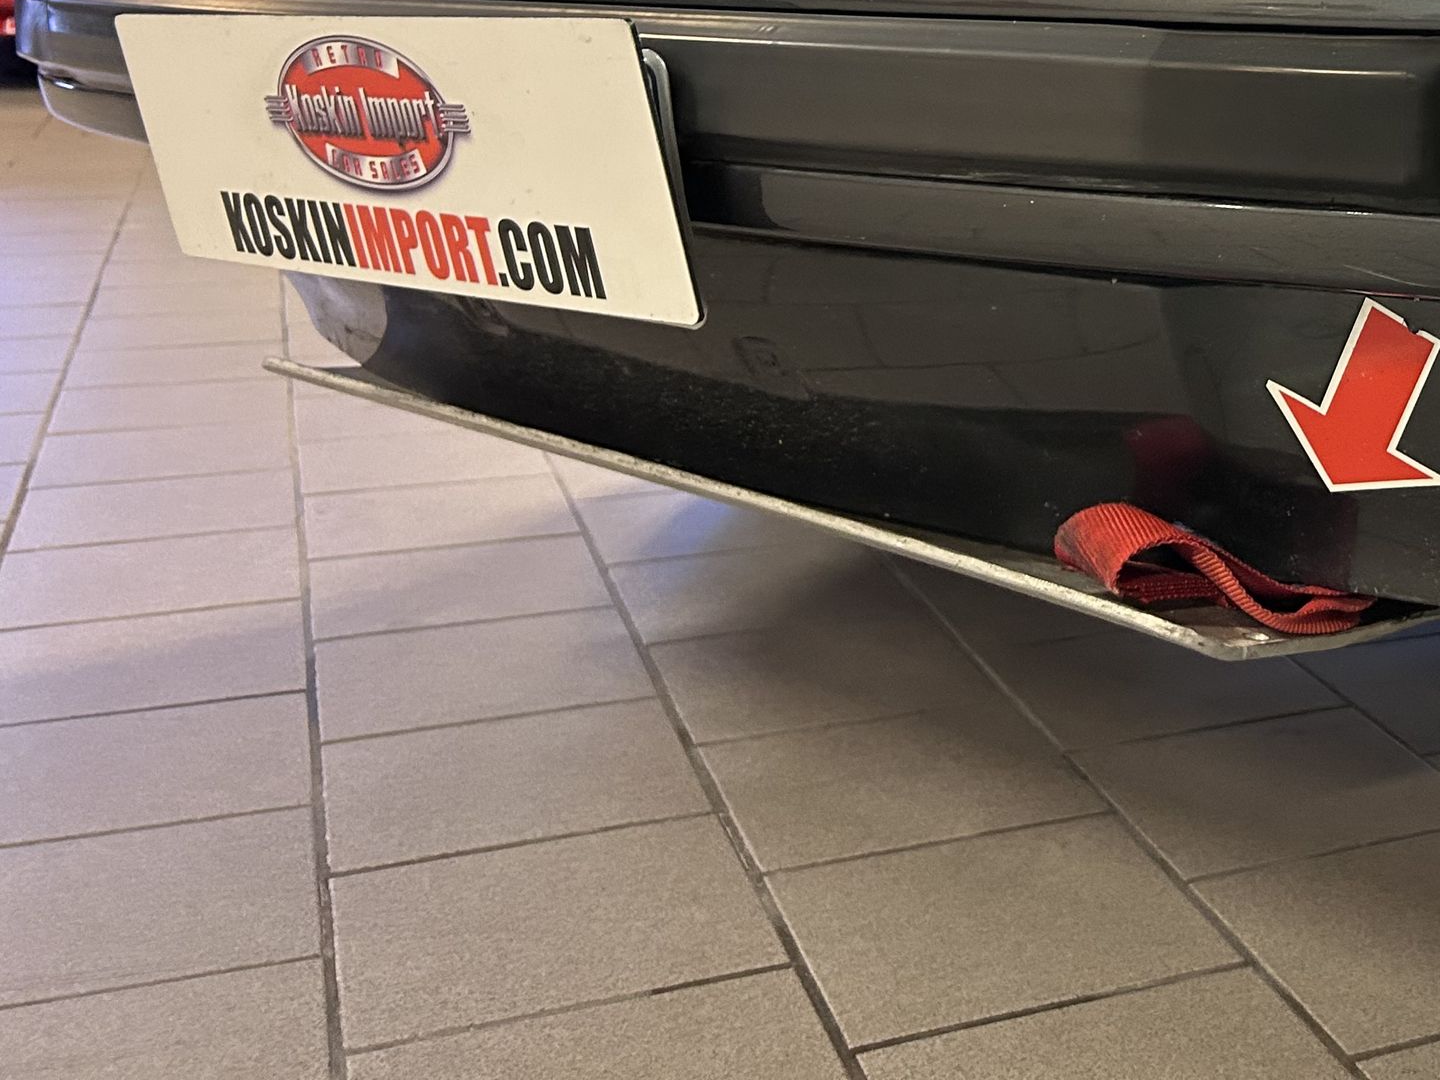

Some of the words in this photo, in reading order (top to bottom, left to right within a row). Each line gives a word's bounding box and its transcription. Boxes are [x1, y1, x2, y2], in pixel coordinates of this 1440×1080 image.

[311, 45, 383, 67] RETRO
[285, 84, 361, 138] Koskin
[358, 87, 443, 148] Import
[369, 155, 422, 180] SALES
[220, 191, 607, 299] KOSKINIMPORT.COM
